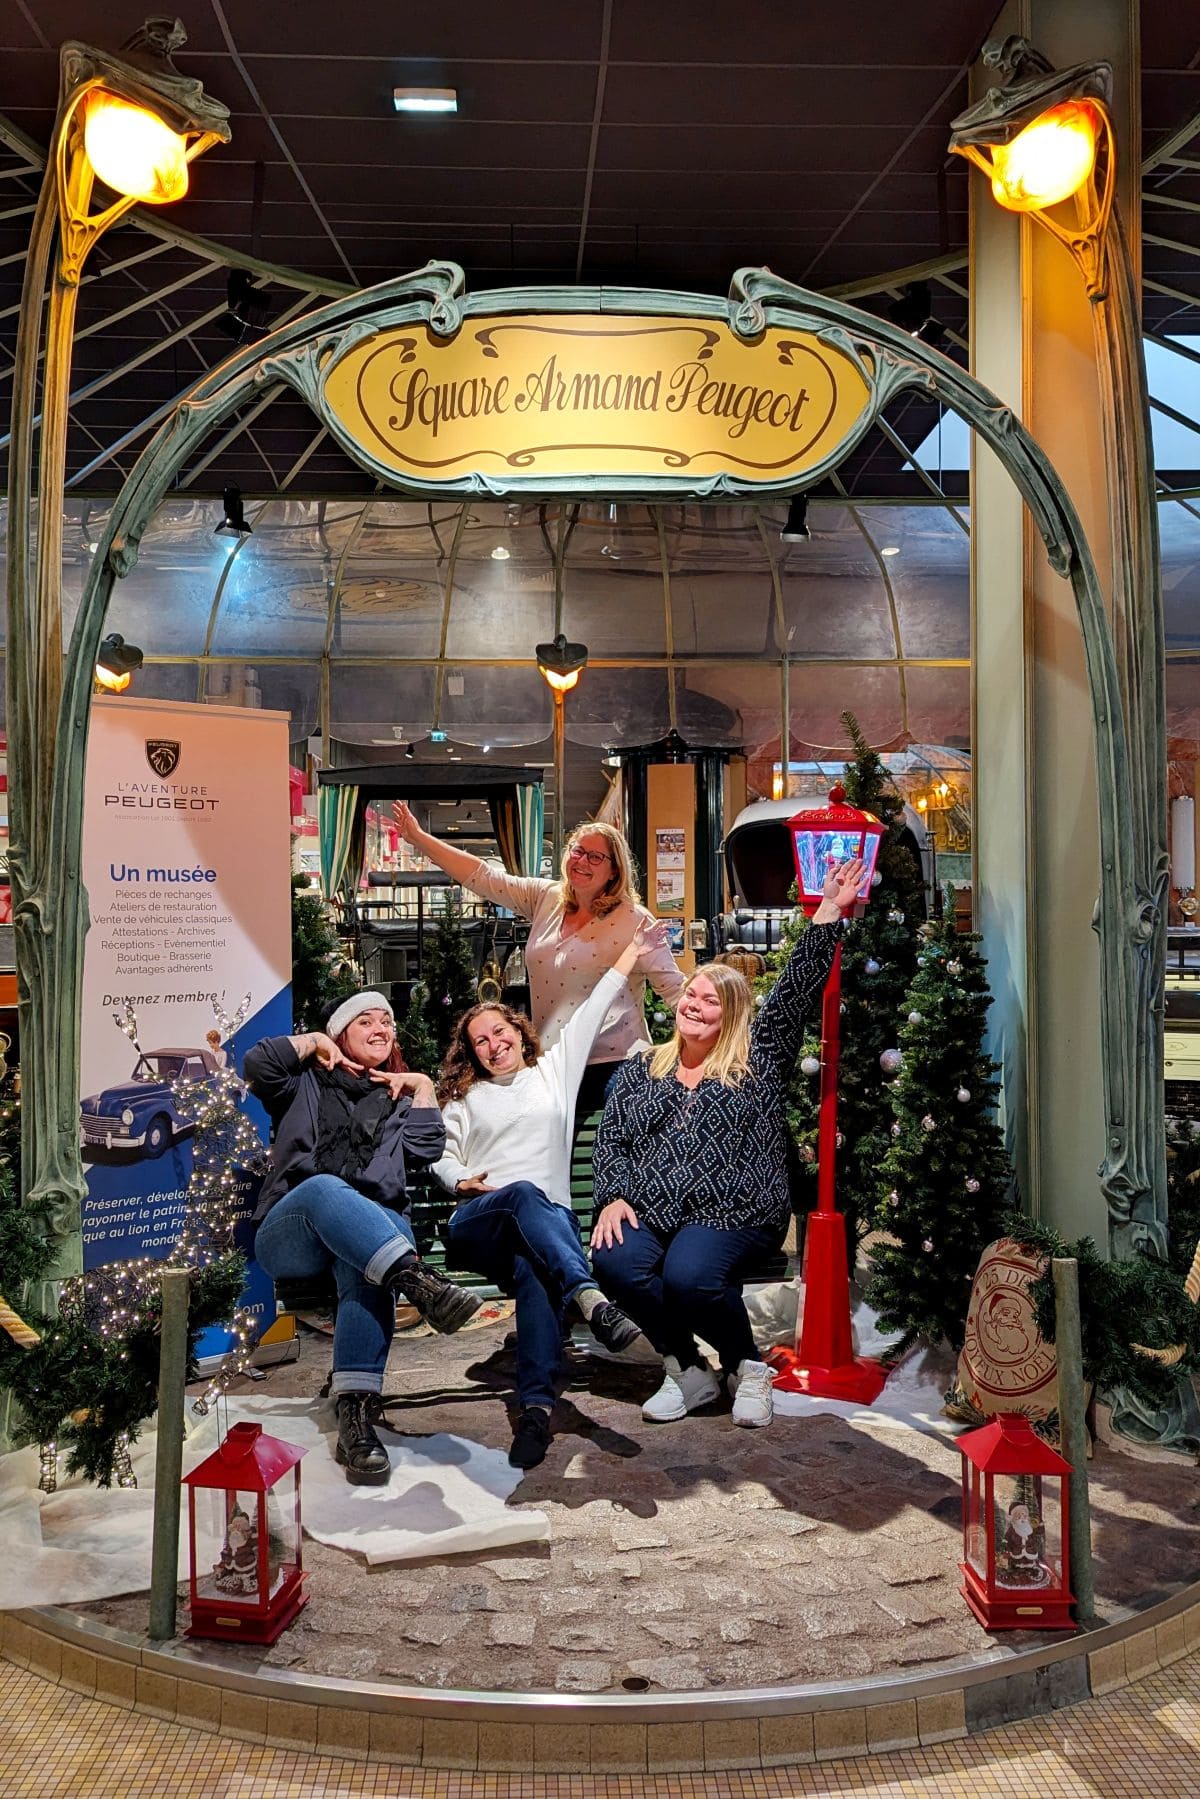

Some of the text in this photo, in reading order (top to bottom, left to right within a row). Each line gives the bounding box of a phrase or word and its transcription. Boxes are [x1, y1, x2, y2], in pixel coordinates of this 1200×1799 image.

[388, 354, 810, 439] Square Armand Peugeot
[118, 782, 208, 796] L'AVENTURE
[105, 795, 219, 810] PEUGEOT
[110, 864, 217, 883] Un musée
[115, 889, 212, 901] Pièces de rechanges
[110, 902, 217, 912] Ateliers de restauration
[93, 914, 232, 925] Vente de véhicules classiques
[112, 927, 168, 937] Attestations
[177, 926, 216, 936] Archives
[101, 940, 155, 950] Réceptions
[117, 953, 160, 963] Boutique
[169, 951, 212, 960] Brasserie
[115, 963, 214, 976] Avantages adhérents
[102, 994, 160, 1006] Devenez
[164, 990, 218, 1003] membre
[85, 1195, 143, 1212] Préserver,
[147, 1187, 197, 1205] dévelop
[82, 1209, 136, 1228] rayonner
[139, 1208, 150, 1219] le
[109, 1228, 124, 1238] au
[128, 1222, 150, 1236] lion
[153, 1222, 167, 1232] en
[983, 1267, 999, 1289] 25
[966, 1330, 1056, 1386] JOYEUX NOËL
